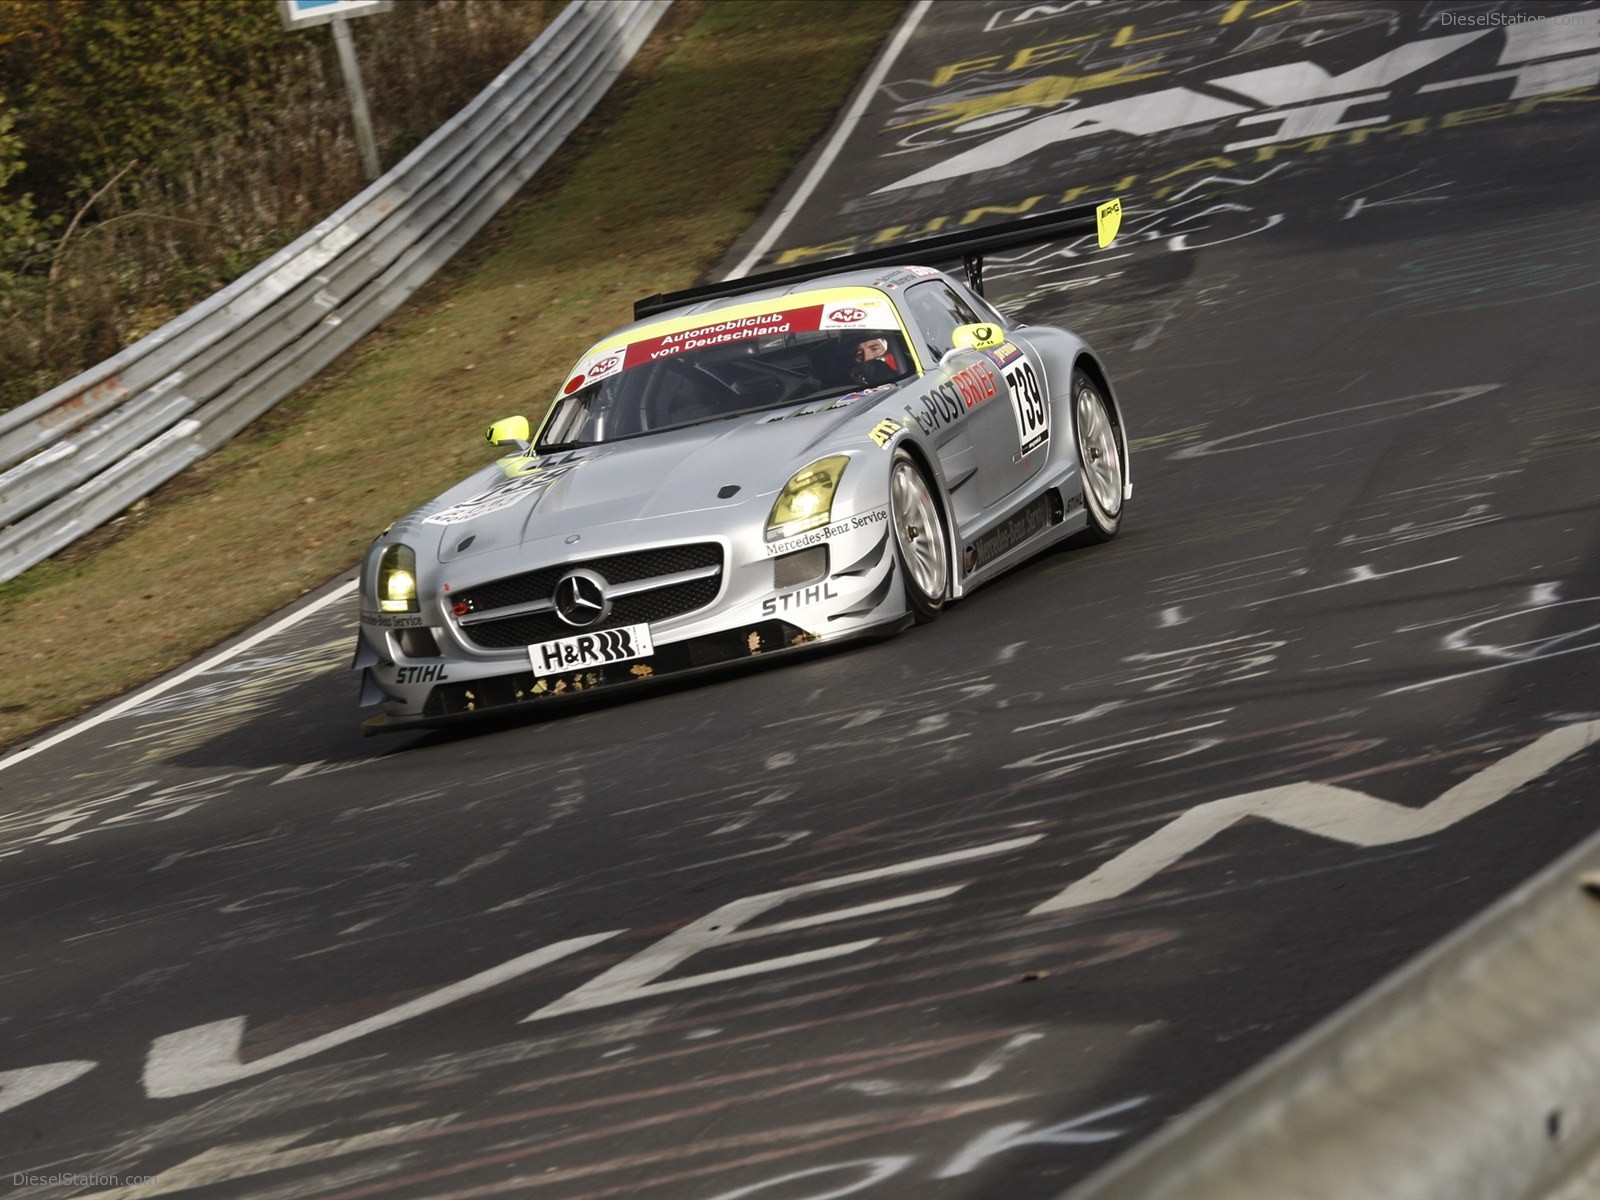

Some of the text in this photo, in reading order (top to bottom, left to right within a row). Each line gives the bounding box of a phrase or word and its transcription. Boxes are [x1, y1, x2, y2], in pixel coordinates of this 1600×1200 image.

[650, 323, 790, 359] von Deutschland
[661, 313, 783, 346] Automobilclub
[1006, 362, 1044, 437] 739
[766, 510, 888, 556] Mercedes-Benz Service
[762, 582, 838, 617] STIHL
[541, 632, 606, 671] H&R
[396, 664, 448, 684] STIHL
